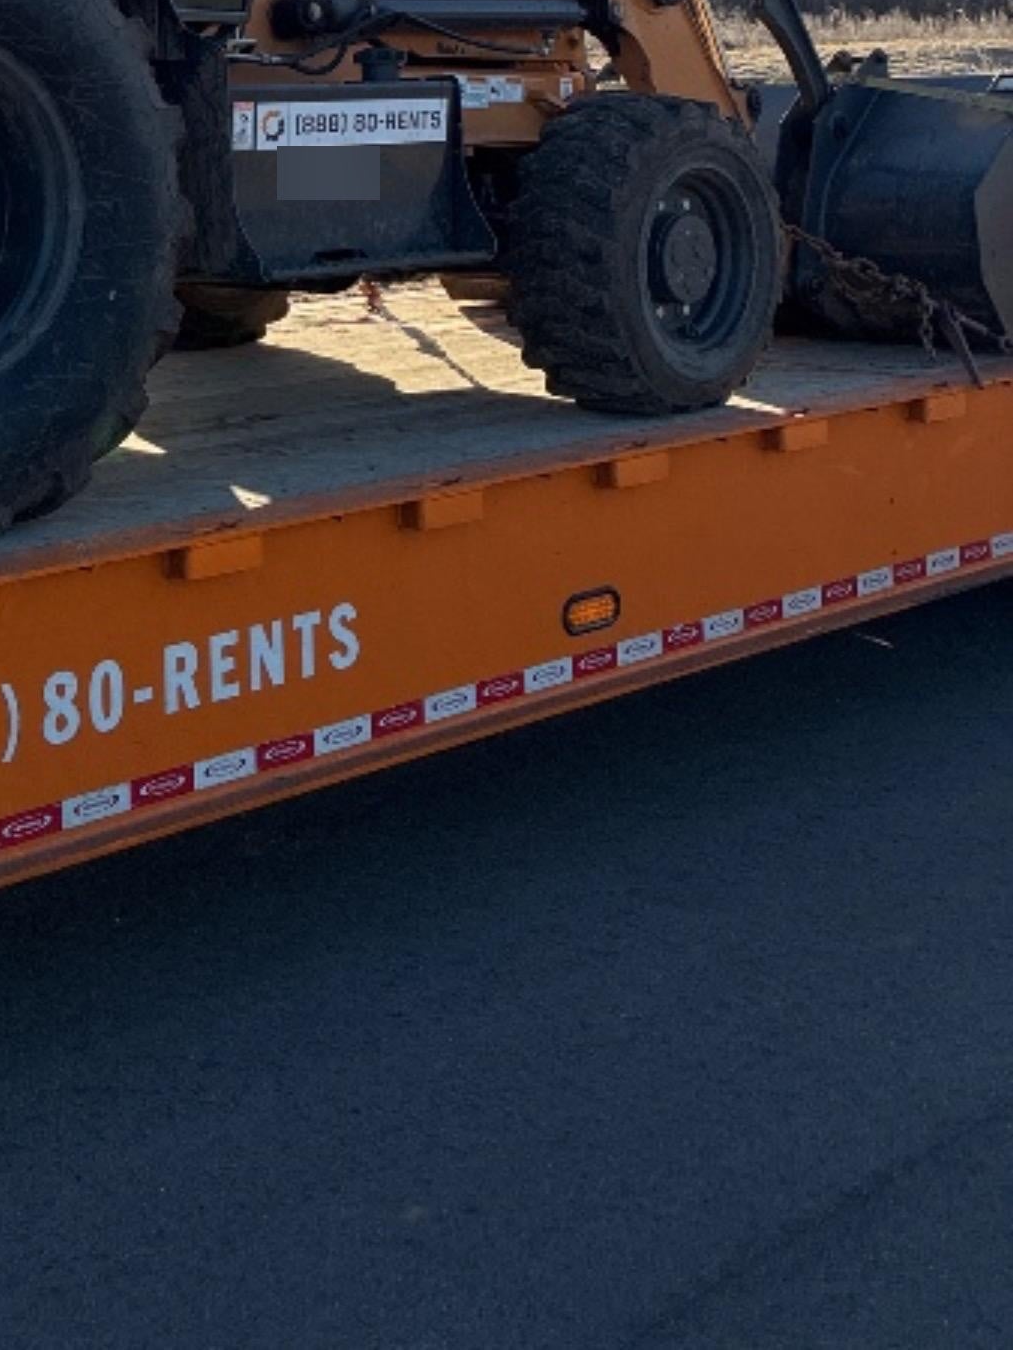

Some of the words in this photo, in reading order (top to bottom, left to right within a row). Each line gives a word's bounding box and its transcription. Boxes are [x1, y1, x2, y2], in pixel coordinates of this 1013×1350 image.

[295, 113, 348, 136] (888)
[353, 110, 442, 133] 80-RENTS
[42, 602, 361, 745] 80-RENTS
